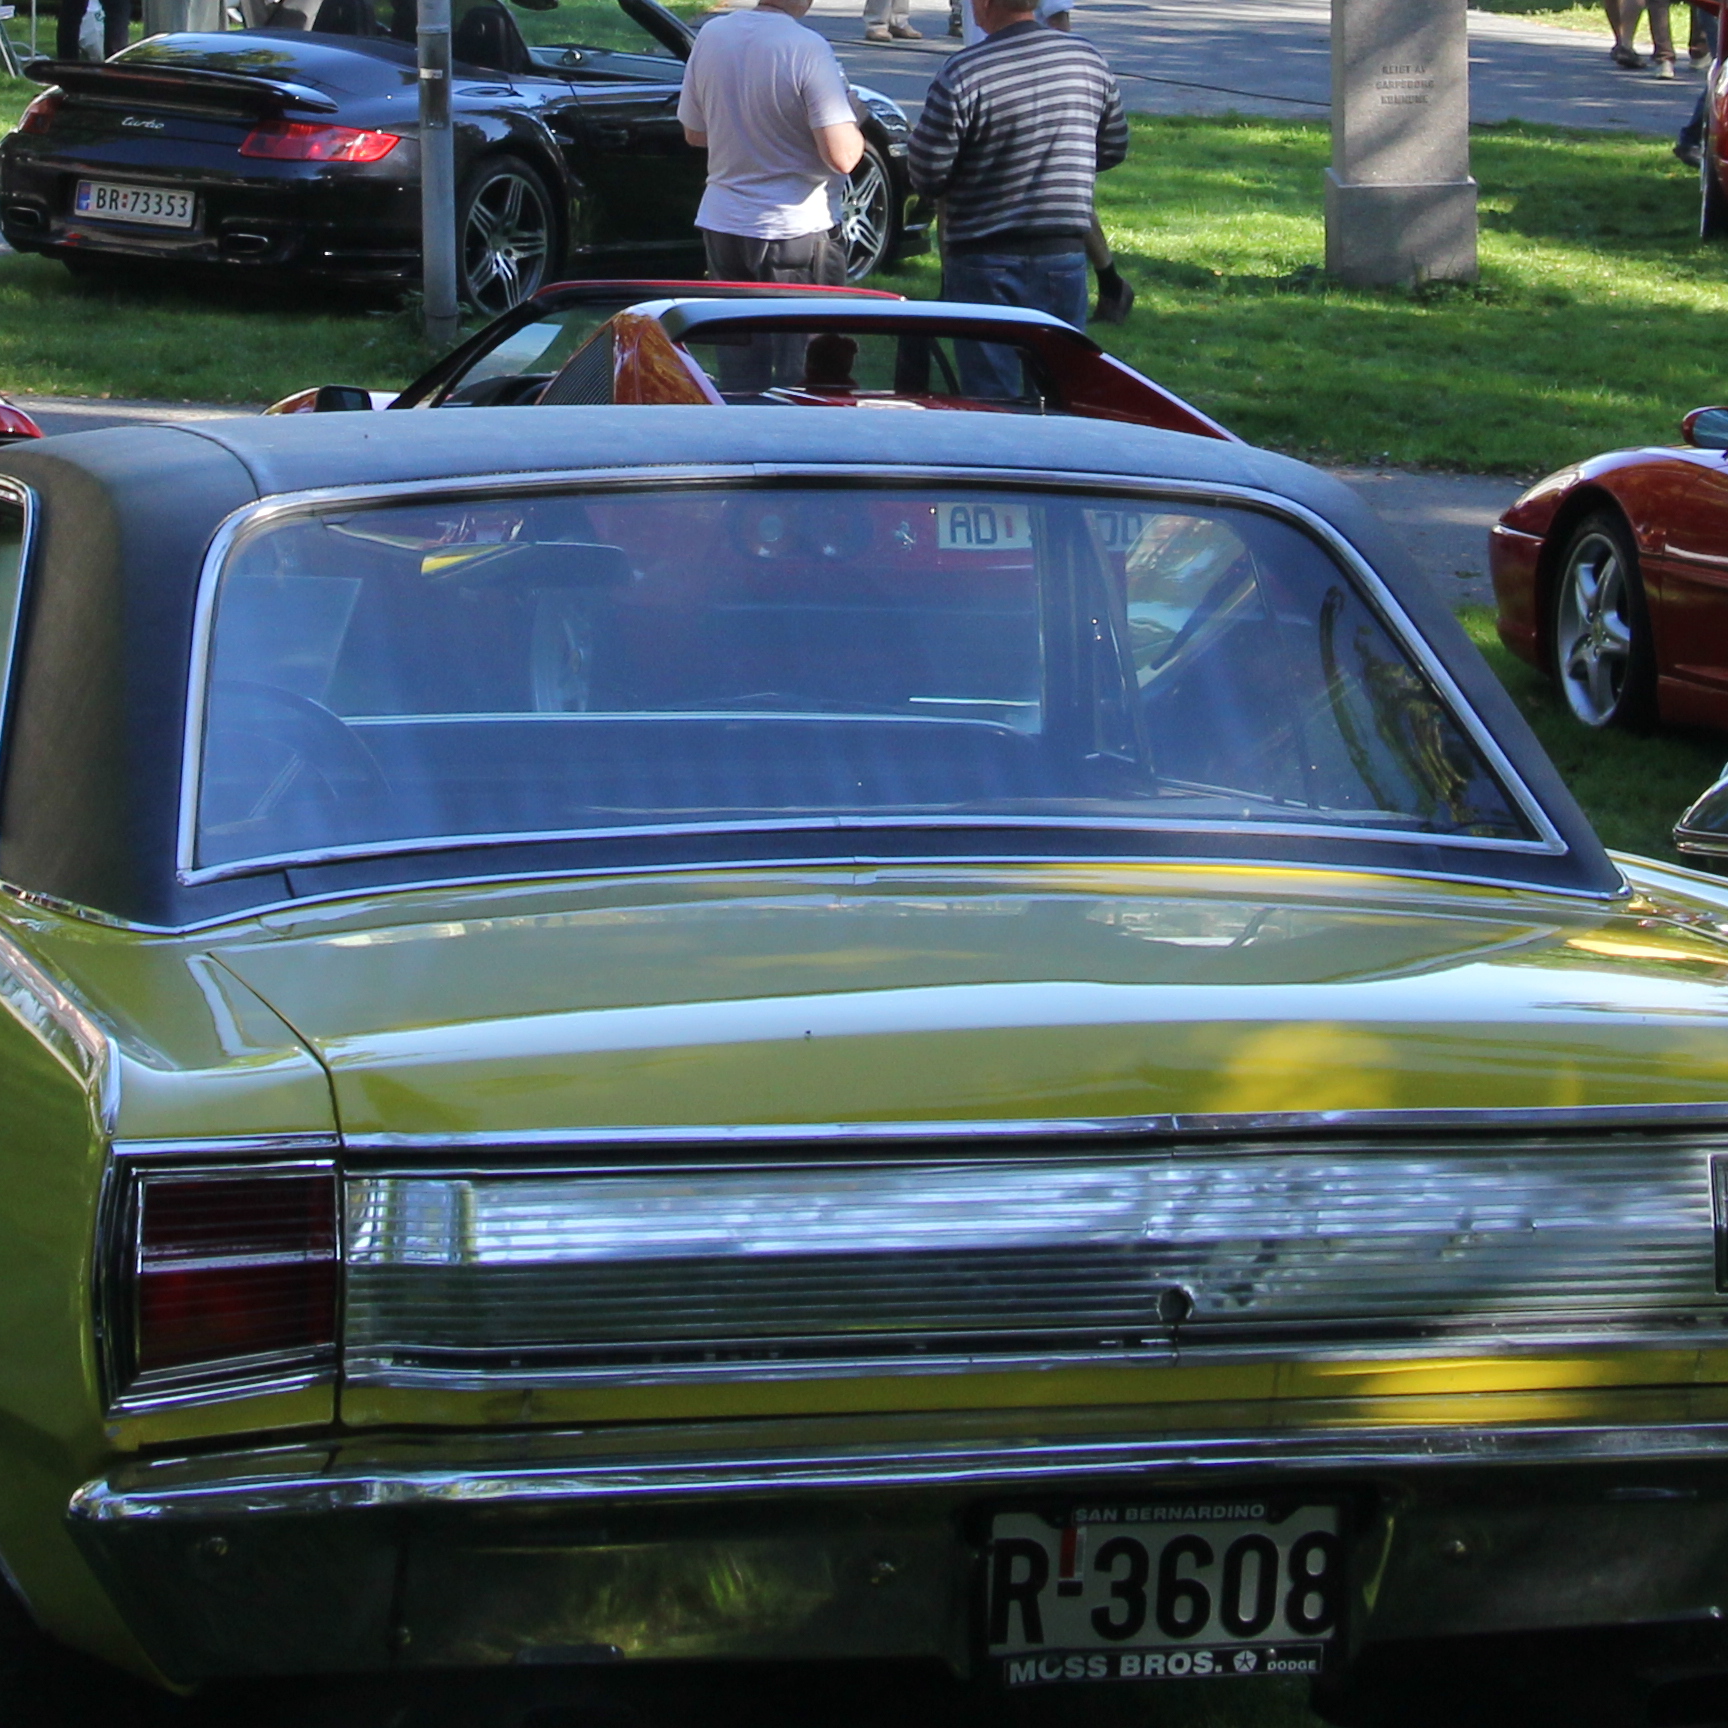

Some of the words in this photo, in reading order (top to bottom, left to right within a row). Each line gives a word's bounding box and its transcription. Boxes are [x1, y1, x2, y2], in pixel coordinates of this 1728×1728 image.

[96, 187, 120, 211] BR
[129, 191, 189, 218] 73353
[950, 505, 998, 545] AD
[1075, 1508, 1118, 1523] SAN
[1124, 1504, 1266, 1522] BERNARDINO
[1009, 1654, 1108, 1685] MOSS
[1119, 1650, 1224, 1678] BROS.
[1267, 1658, 1318, 1671] DODGE
